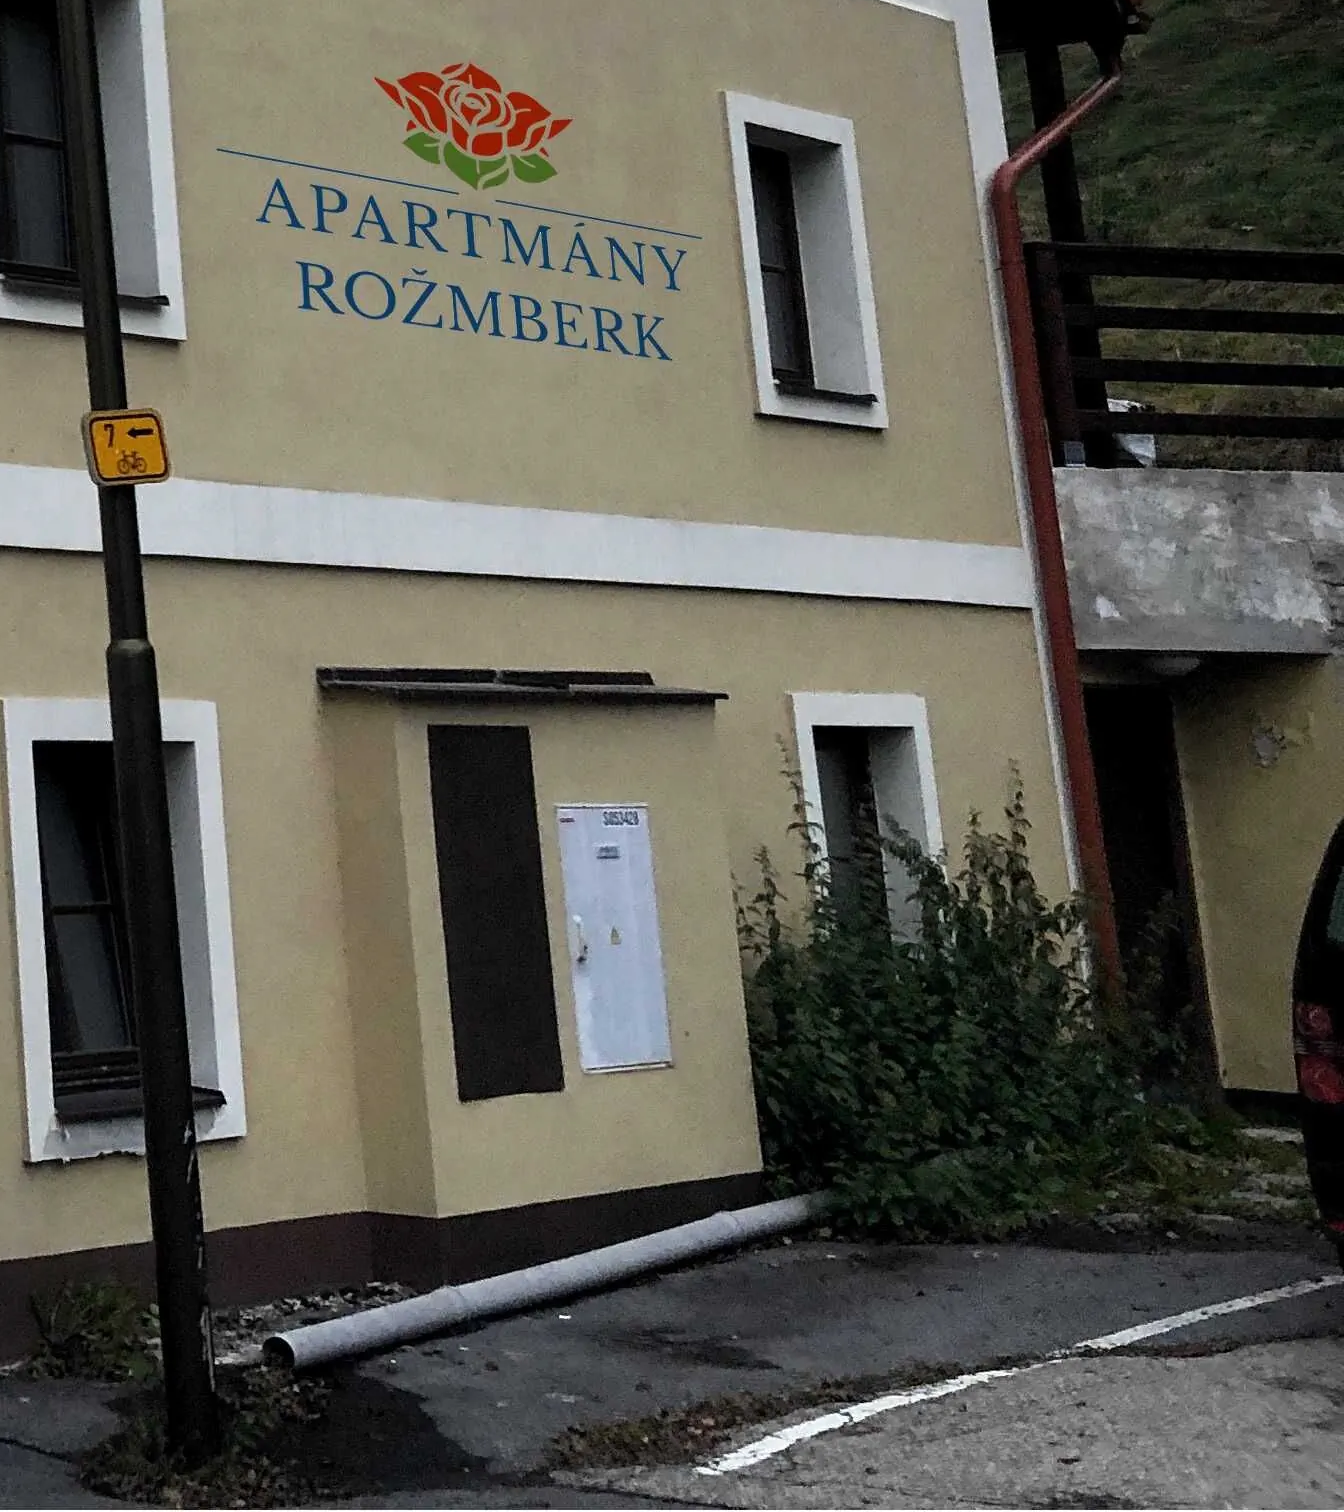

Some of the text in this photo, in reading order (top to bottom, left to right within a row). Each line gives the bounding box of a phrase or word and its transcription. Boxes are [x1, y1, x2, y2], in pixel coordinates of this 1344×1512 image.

[256, 177, 688, 292] APARTMÁNY
[295, 260, 673, 362] ROŽMBERK
[104, 423, 115, 448] 7
